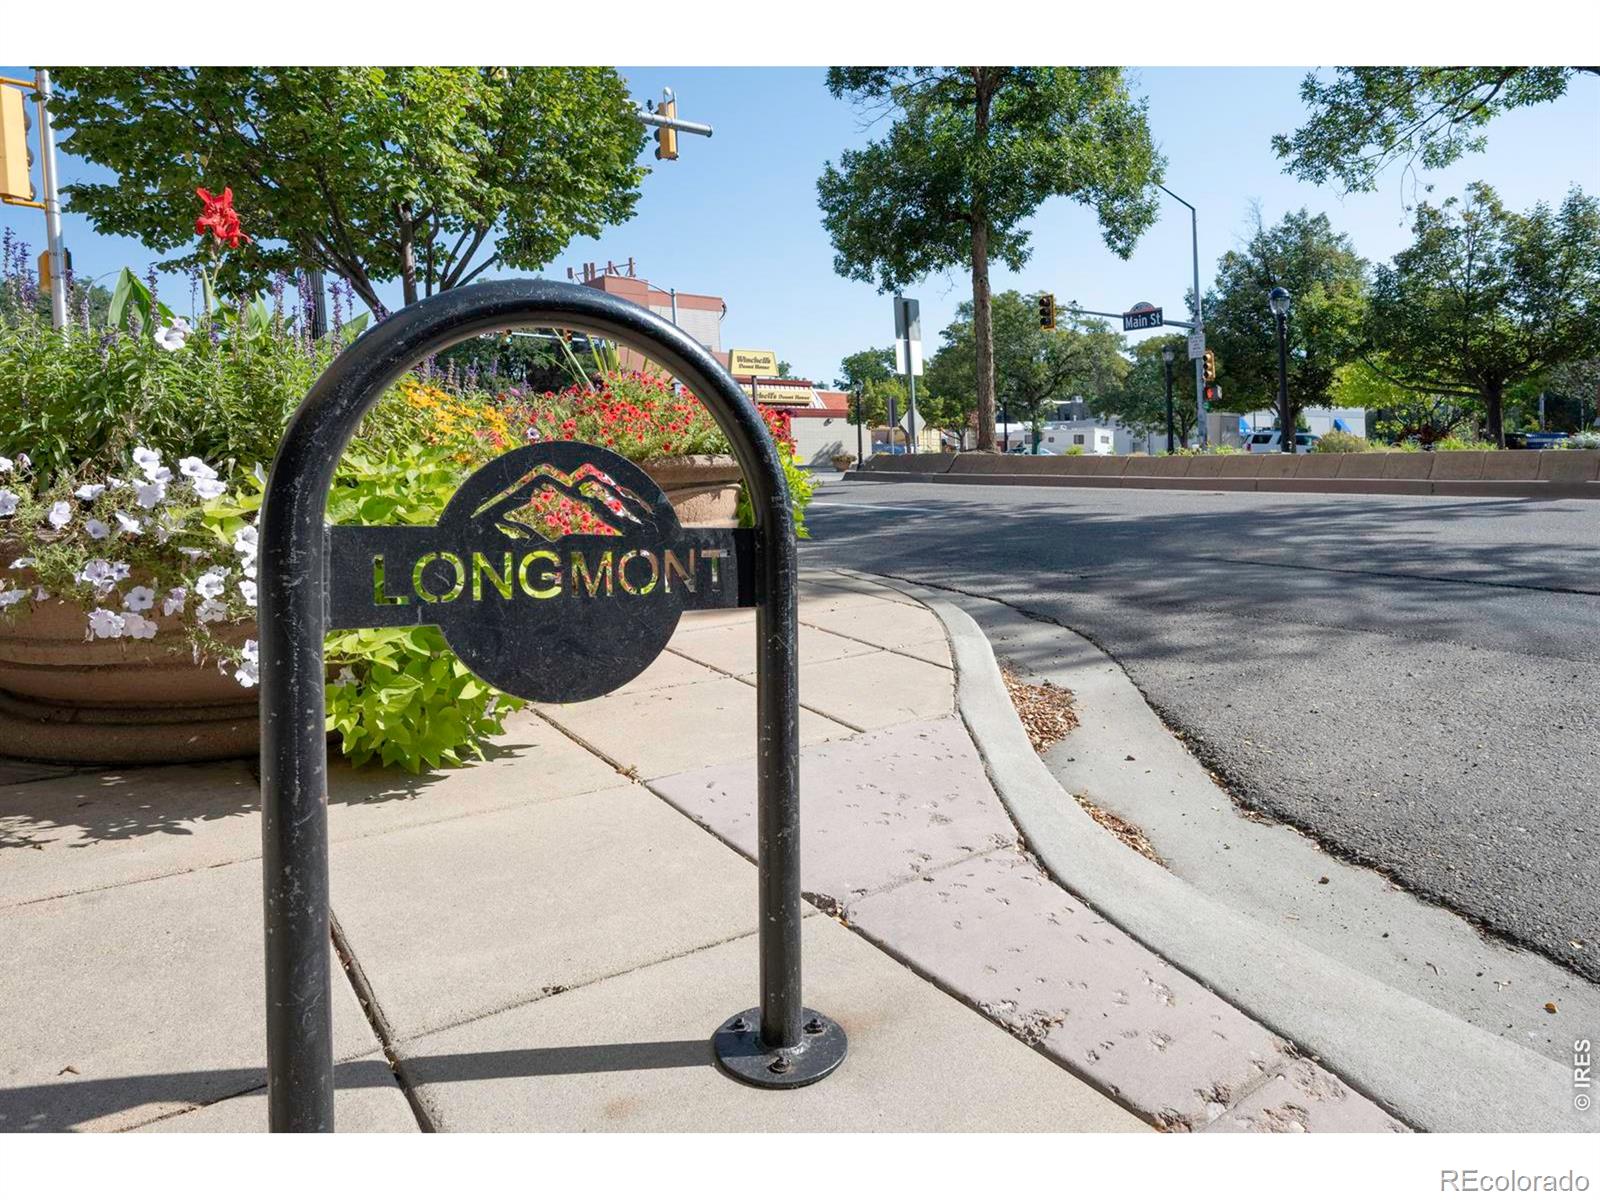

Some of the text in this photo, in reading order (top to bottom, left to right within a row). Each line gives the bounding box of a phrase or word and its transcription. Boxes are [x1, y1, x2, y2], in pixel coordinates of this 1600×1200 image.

[1125, 312, 1161, 329] Main St
[373, 549, 729, 606] LONGMONT
